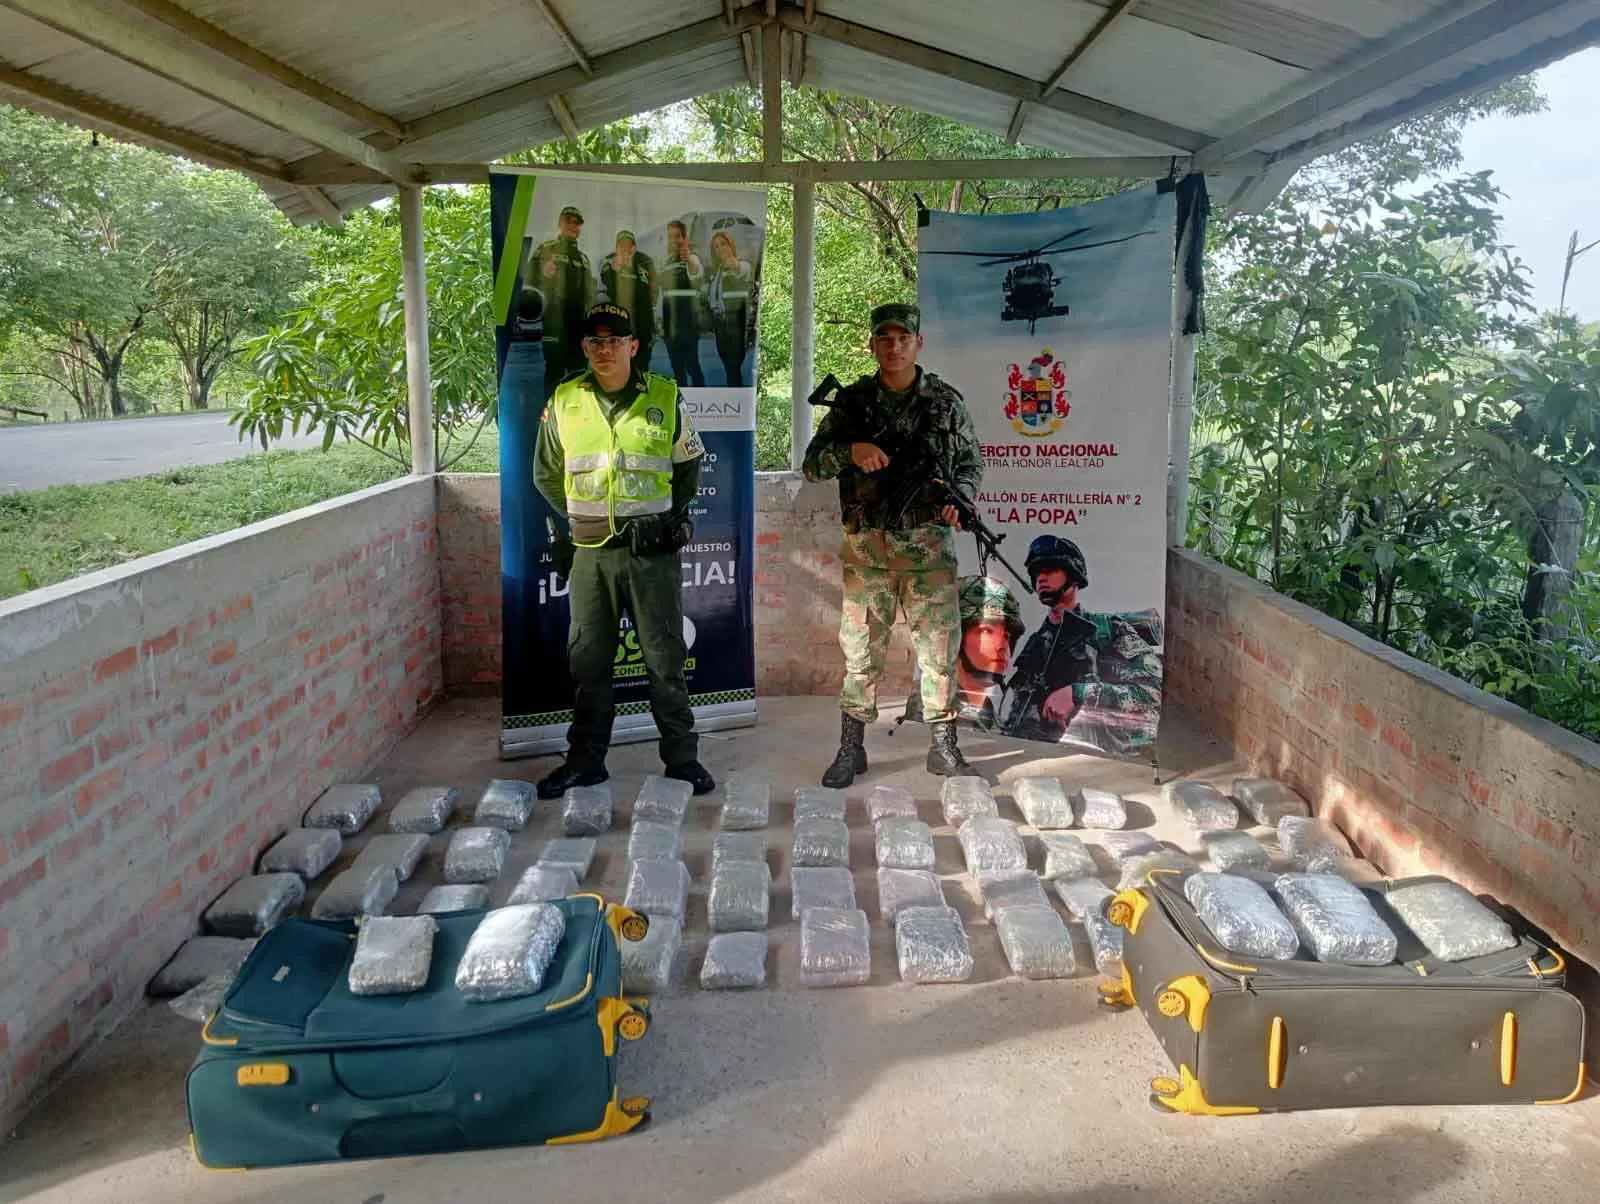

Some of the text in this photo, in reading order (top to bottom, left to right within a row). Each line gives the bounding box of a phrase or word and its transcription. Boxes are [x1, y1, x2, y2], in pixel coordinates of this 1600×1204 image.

[980, 442, 1118, 458] ÉRCITO NACIONAL
[981, 457, 1104, 468] ATRIA HONOR LEALTAD
[973, 490, 1017, 503] ALLÓN
[1021, 492, 1037, 504] DE
[1040, 490, 1113, 505] ARTILLERÍA
[1134, 494, 1142, 506] 2
[682, 542, 732, 553] NUESTRO
